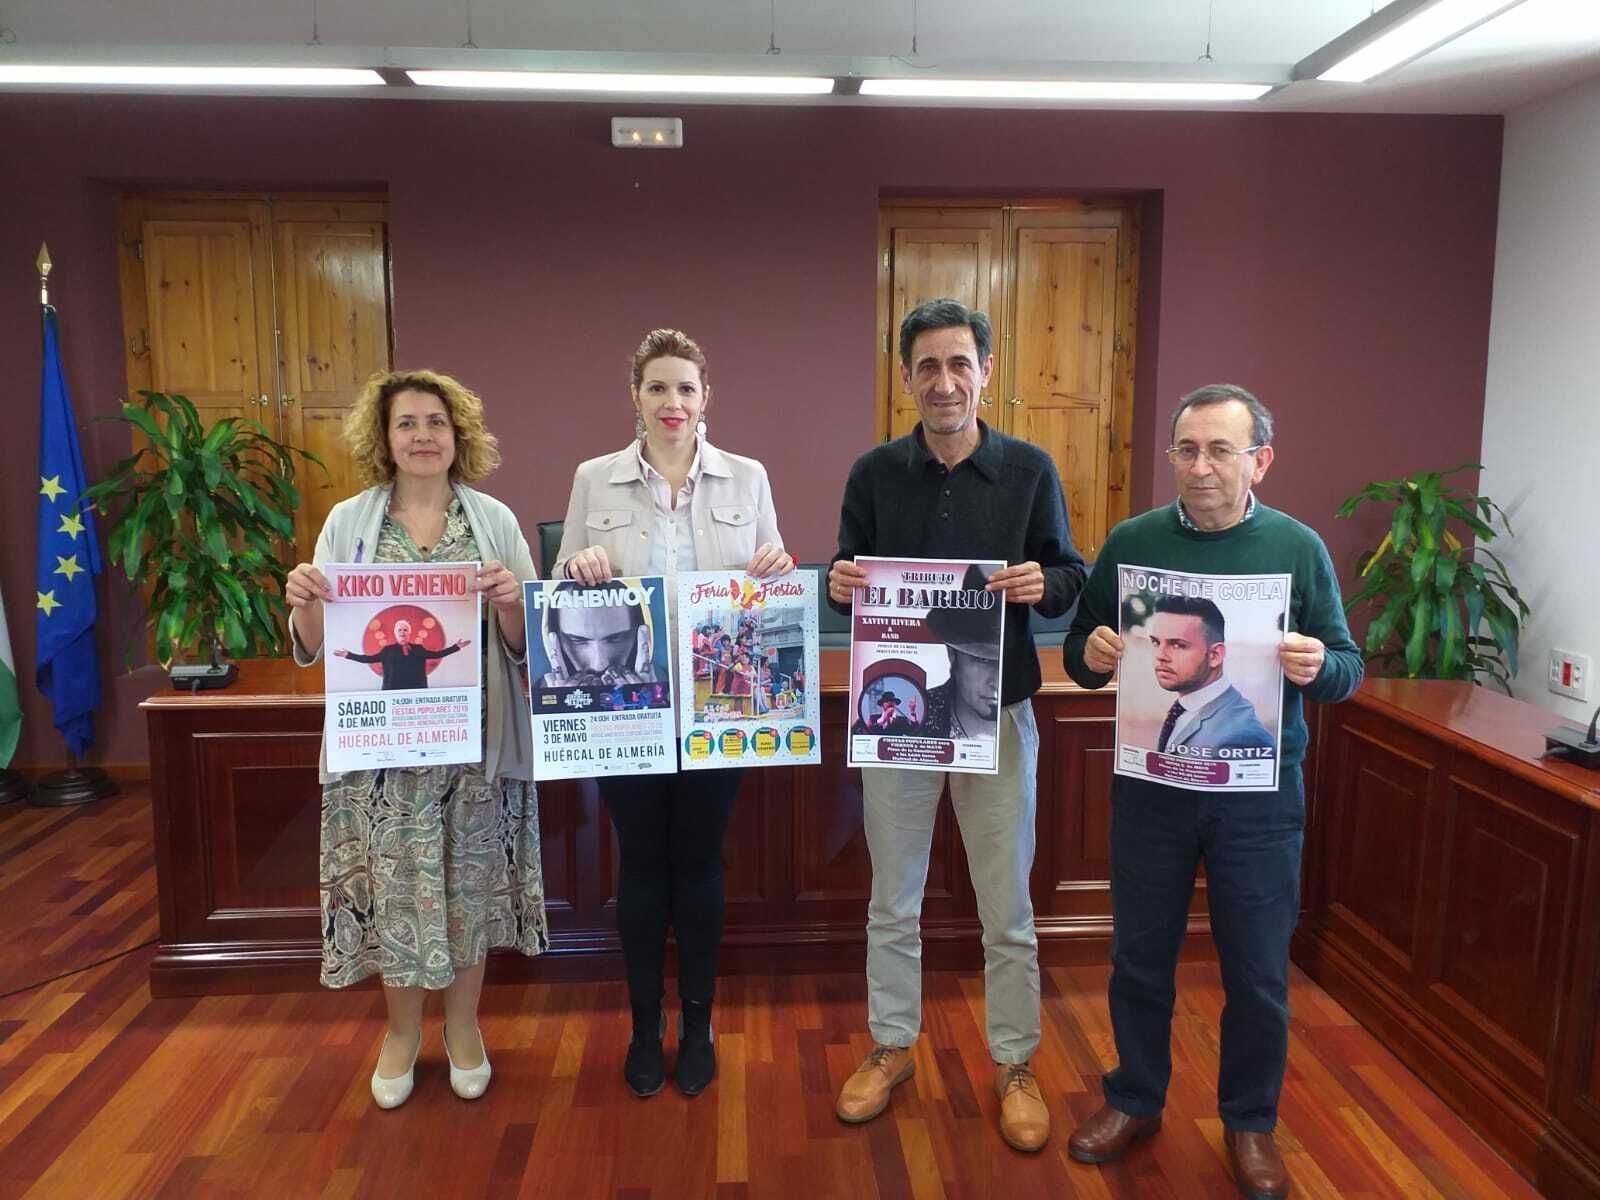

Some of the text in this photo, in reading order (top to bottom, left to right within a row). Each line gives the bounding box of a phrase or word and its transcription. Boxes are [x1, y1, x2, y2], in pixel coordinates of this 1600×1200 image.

[337, 574, 467, 597] KIKO VENENO
[901, 571, 954, 584] TRIBUTO
[1122, 570, 1283, 600] NOCHE DE COPLA
[533, 586, 655, 609] FYAHBWOY
[690, 579, 806, 605] Feria Fiestas
[862, 585, 995, 610] EL BARRIO
[890, 618, 921, 627] RIVERA
[337, 697, 386, 716] SÁBADO
[337, 719, 344, 729] 4
[346, 717, 358, 728] DE
[360, 716, 387, 728] MAYO
[543, 718, 587, 732] VIERNES
[338, 728, 468, 749] HUÉRCAL DE ALMERÍA
[543, 734, 549, 744] 3
[551, 733, 562, 744] DE
[564, 732, 587, 743] MAYO
[544, 743, 665, 763] HUÉRCAL DE ALMERÍA
[1167, 743, 1273, 758] JOSE ORTIZ
